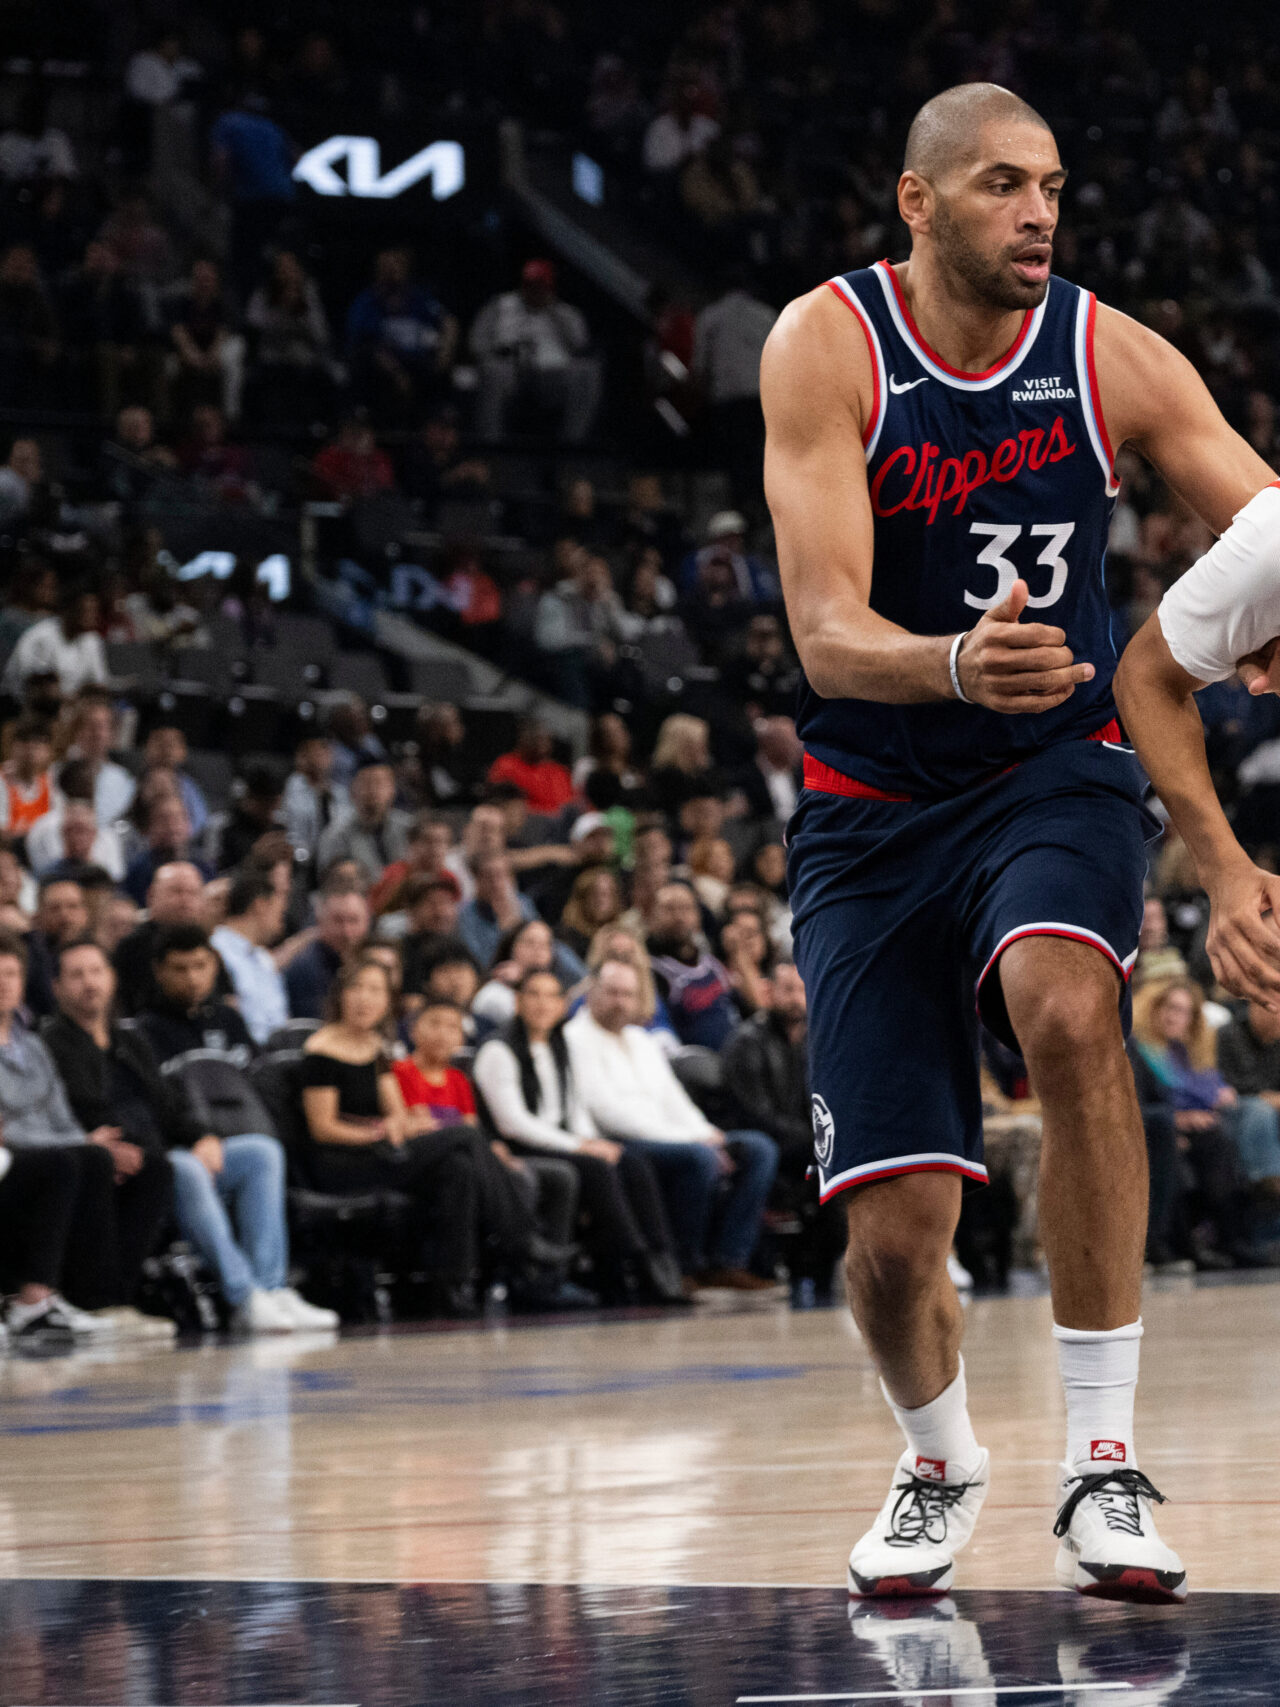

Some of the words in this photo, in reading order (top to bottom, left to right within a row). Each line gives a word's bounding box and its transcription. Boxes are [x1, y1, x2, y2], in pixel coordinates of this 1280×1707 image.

[1012, 387, 1076, 402] RWANDA
[1023, 376, 1061, 390] VISIT
[870, 416, 1077, 526] Clippers
[963, 521, 1076, 610] 33
